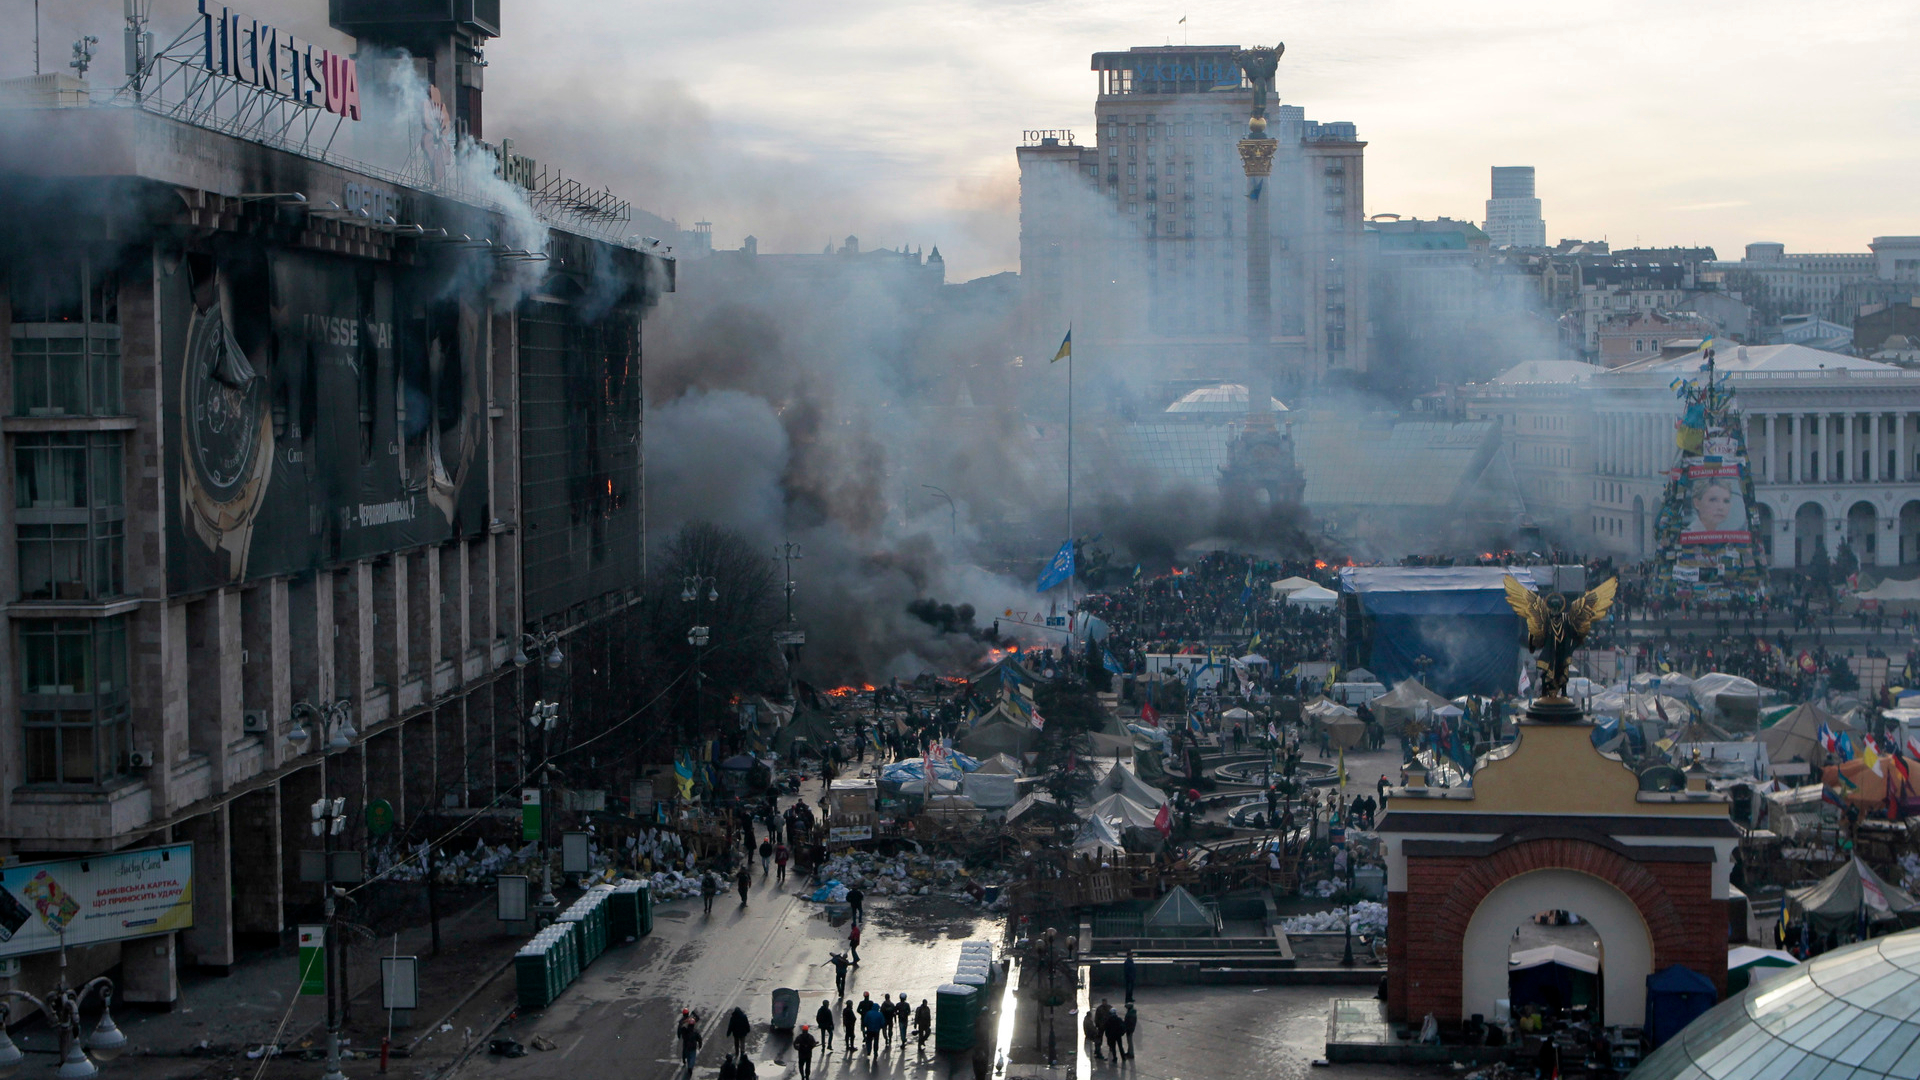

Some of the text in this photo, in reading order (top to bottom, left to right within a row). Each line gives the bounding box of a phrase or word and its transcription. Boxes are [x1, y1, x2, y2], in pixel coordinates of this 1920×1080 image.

[1136, 60, 1241, 82] УКРАЇНА
[1022, 129, 1075, 142] ГОТЕЛЬ
[411, 494, 416, 518] 2
[115, 857, 161, 879] Lucky Card
[92, 888, 184, 908] ЩО ПРИНОСИТЬ УДАЧУ
[96, 878, 180, 897] БАНКІВСЬКА КАРТКА,
